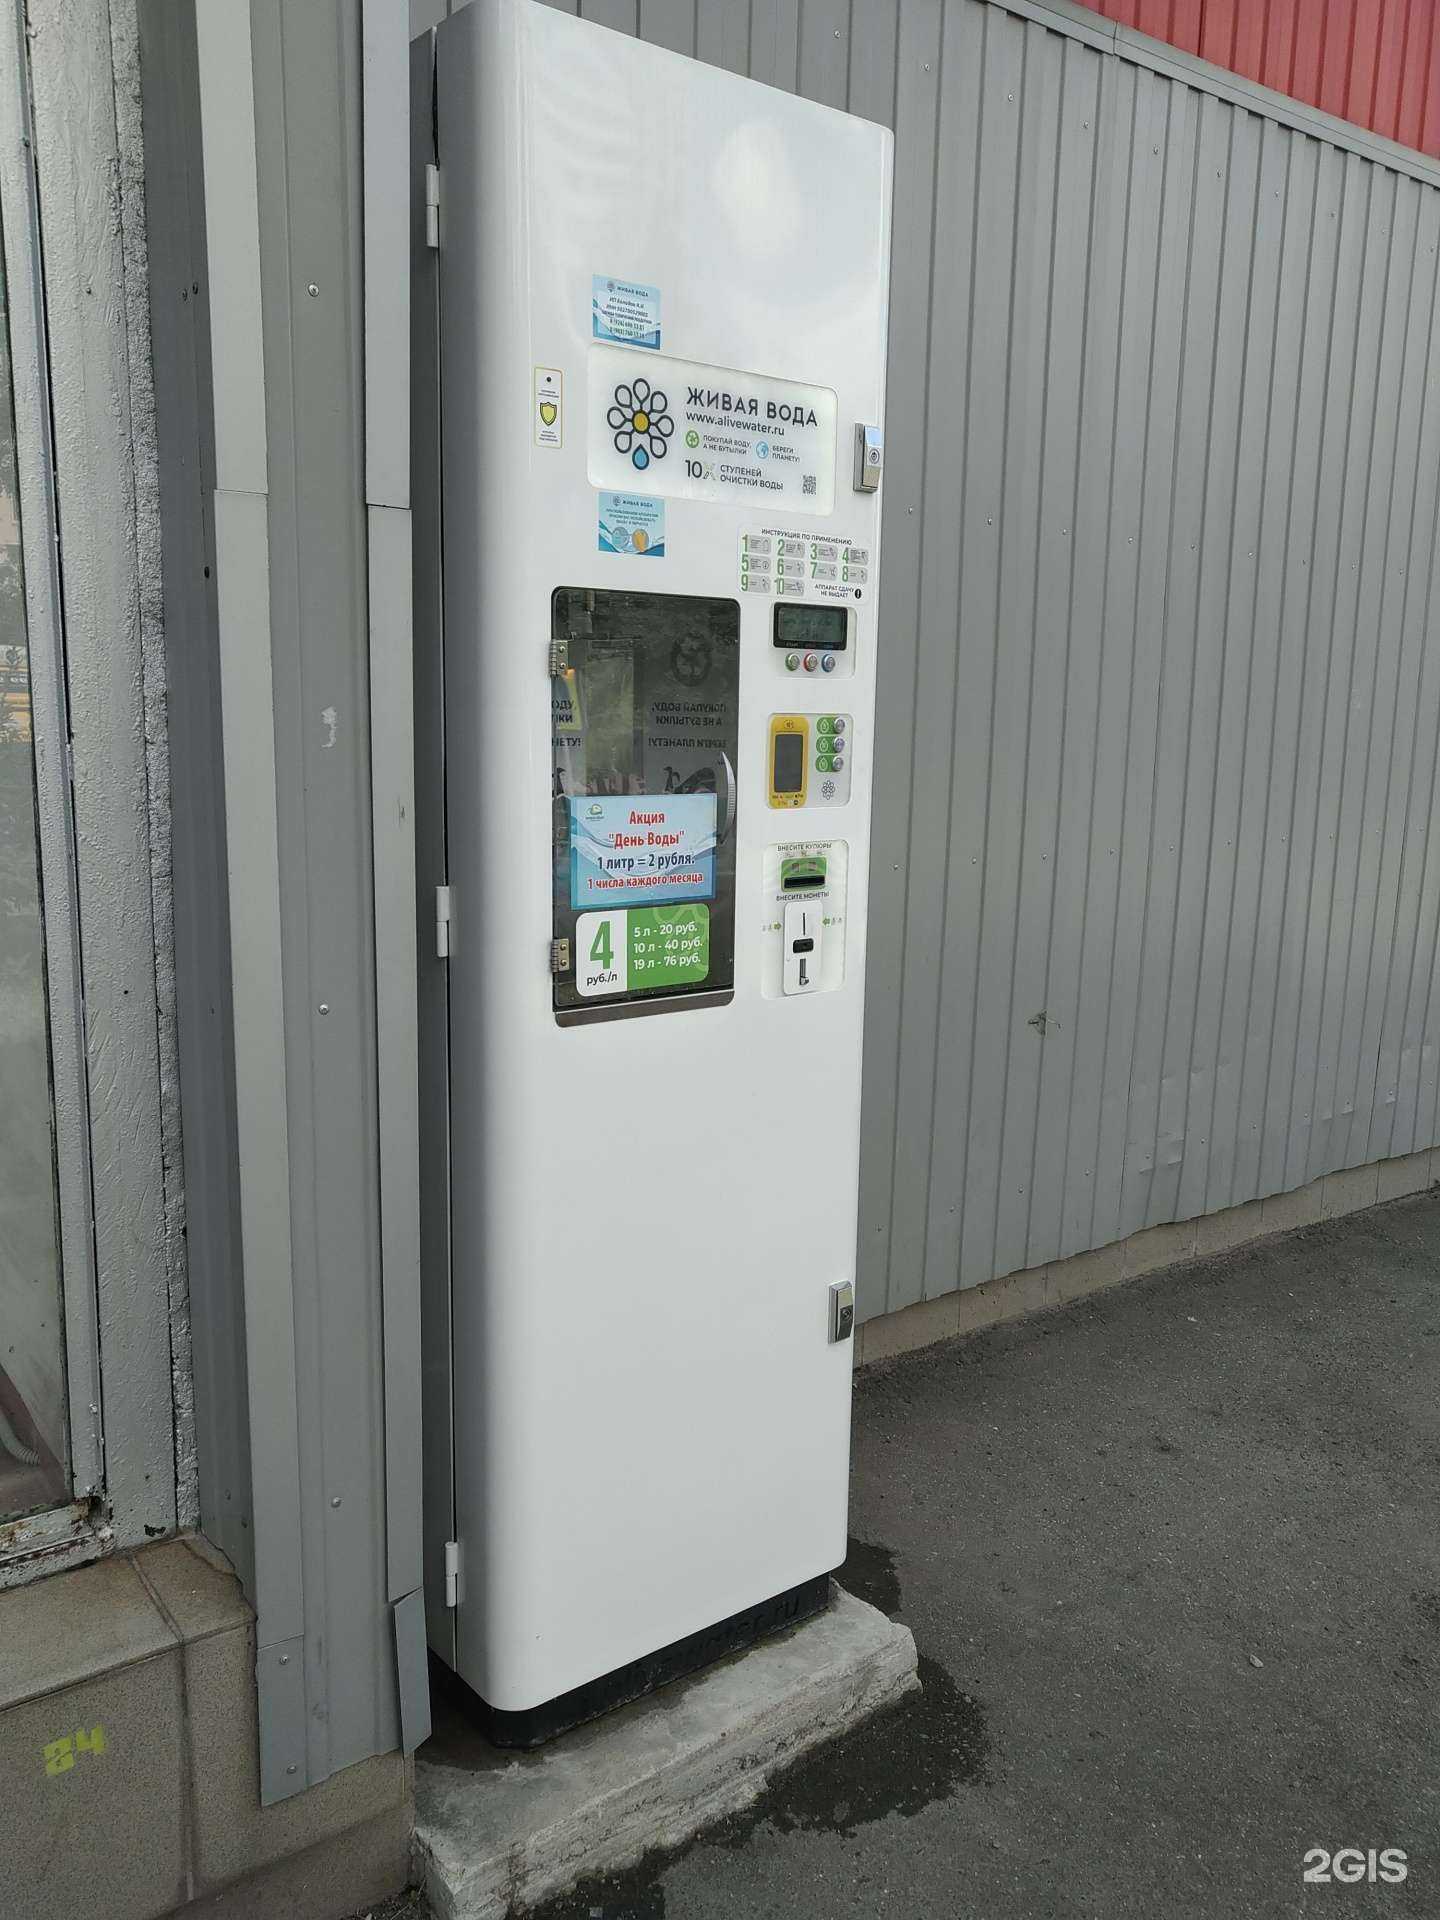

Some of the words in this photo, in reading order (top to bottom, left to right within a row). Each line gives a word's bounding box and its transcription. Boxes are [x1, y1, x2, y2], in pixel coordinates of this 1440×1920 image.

[686, 387, 758, 416] ЖИВАЯ
[767, 402, 818, 427] ВОДА
[686, 412, 785, 436] www.alivewater.ru
[703, 435, 732, 445] ПОКУПАЙ
[718, 446, 747, 455] БУТЫЛКИ
[772, 445, 794, 453] БЕРЕГИ
[685, 460, 703, 479] 10
[720, 464, 762, 477] СТУПЕНЕЙ
[720, 475, 758, 487] ОЧИСТКИ
[760, 480, 784, 490] ВОДЫ
[742, 534, 749, 552] 1
[761, 529, 800, 539] ИНСТРУКЦИЯ
[801, 533, 810, 541] ПО
[811, 535, 853, 546] ПРИМЕНЕНИЮ
[777, 539, 785, 557] 2
[810, 543, 817, 560] 3
[842, 547, 849, 564] 4
[741, 554, 749, 572] 5
[777, 558, 785, 576] 6
[810, 562, 817, 579] 7
[741, 574, 749, 591] 9
[842, 566, 849, 582] 8
[774, 578, 785, 595] 10
[815, 583, 837, 591] АППАРАТ
[629, 811, 665, 826] Акция
[609, 833, 644, 849] "День
[647, 831, 685, 848] Воды"
[777, 844, 804, 852] ВНЕСИТЕ
[805, 842, 832, 850] КУПЮРЫ
[597, 857, 603, 869] 1
[606, 858, 635, 871] литр
[648, 854, 655, 867] 2
[657, 852, 695, 869] рубля.
[588, 879, 593, 889] 1
[595, 878, 624, 889] числа
[626, 875, 667, 887] каждого
[669, 873, 703, 884] месяца
[776, 894, 803, 902] ВНЕСИТЕ
[803, 891, 829, 899] МОНЕТЫ
[634, 927, 641, 938] 5
[642, 928, 651, 936] л
[660, 924, 673, 935] 20
[675, 921, 697, 935] руб.
[589, 920, 614, 970] 4
[633, 942, 646, 954] 10
[647, 944, 655, 953] л
[664, 939, 679, 950] 40
[681, 936, 703, 951] руб.
[633, 959, 645, 970] 19
[647, 960, 655, 969] л
[664, 955, 676, 967] 76
[679, 953, 701, 967] руб.
[586, 971, 618, 986] руб./л
